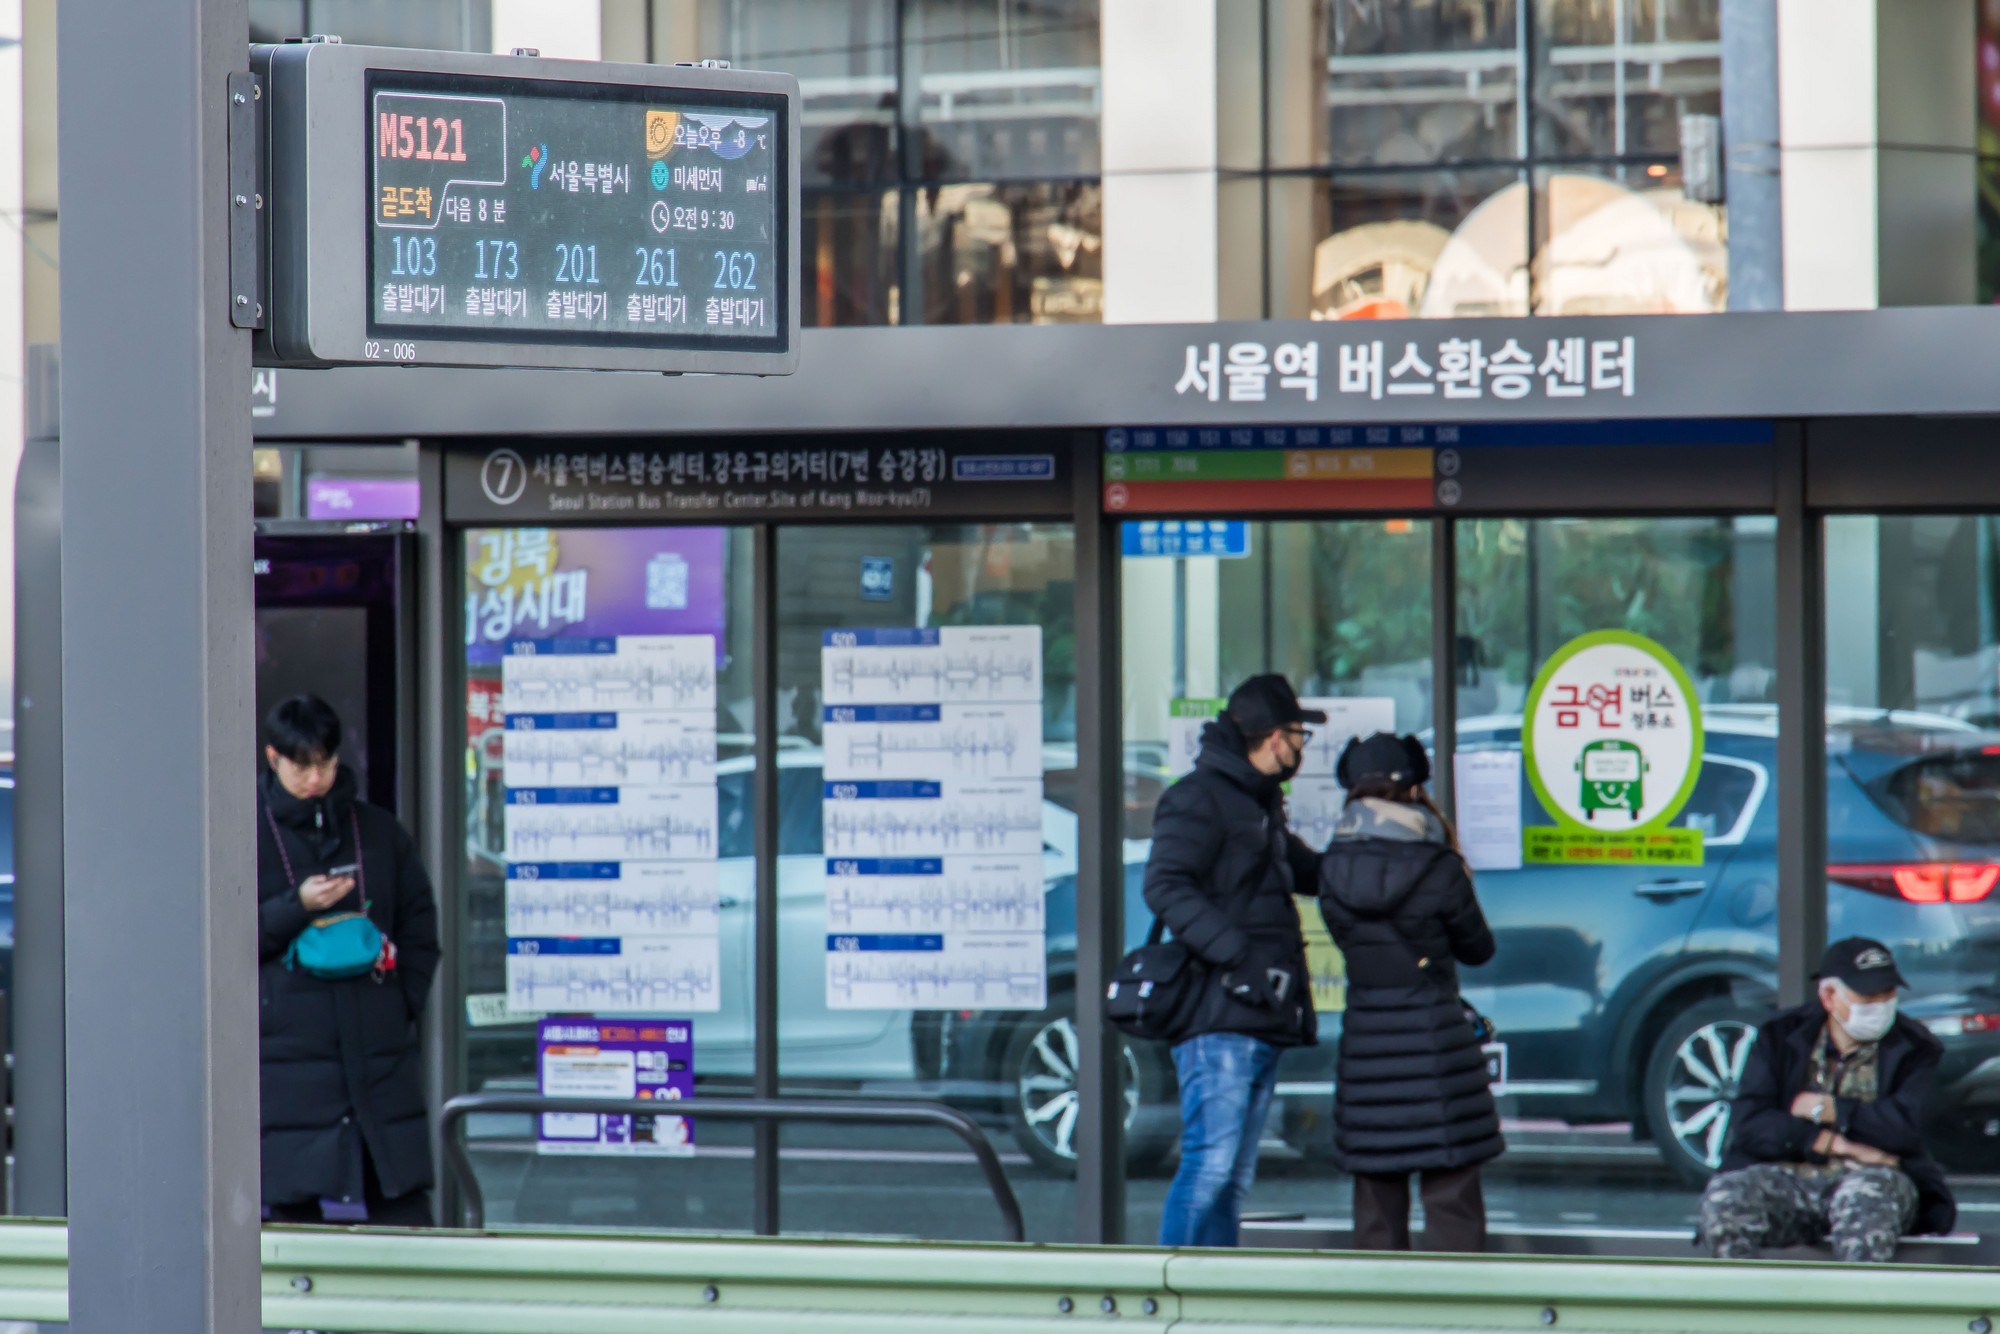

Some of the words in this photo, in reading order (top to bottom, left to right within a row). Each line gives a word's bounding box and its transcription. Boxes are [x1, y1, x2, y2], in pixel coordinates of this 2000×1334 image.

[379, 112, 468, 163] M5121
[549, 160, 630, 194] 서울특별시
[674, 165, 722, 192] 미세먼지
[381, 186, 433, 219] 곧도착
[446, 196, 472, 223] 다음
[478, 198, 488, 222] 8
[492, 199, 507, 223] 분
[672, 206, 698, 229] 오전
[391, 235, 437, 276] 103
[474, 239, 519, 280] 173
[555, 243, 600, 284] 201
[635, 247, 679, 288] 261
[714, 250, 757, 291] 262
[382, 282, 446, 315] 출발대기
[465, 286, 528, 318] 출발대기
[546, 289, 608, 321] 출발대기
[626, 292, 687, 324] 출발대기
[705, 295, 765, 327] 출발대기
[1174, 341, 1320, 402] 서울역
[1337, 336, 1637, 401] 버스환승센터
[877, 448, 947, 484] 승강장)
[548, 492, 584, 511] Seoul
[587, 491, 635, 510] Station
[637, 491, 661, 509] Bus
[665, 491, 719, 509] Transfer
[800, 489, 815, 507] of
[819, 489, 852, 511] Kang
[479, 528, 551, 587] 강북
[1550, 683, 1622, 728] 금연
[1629, 683, 1676, 709] 버스
[1631, 711, 1676, 731] 정류소
